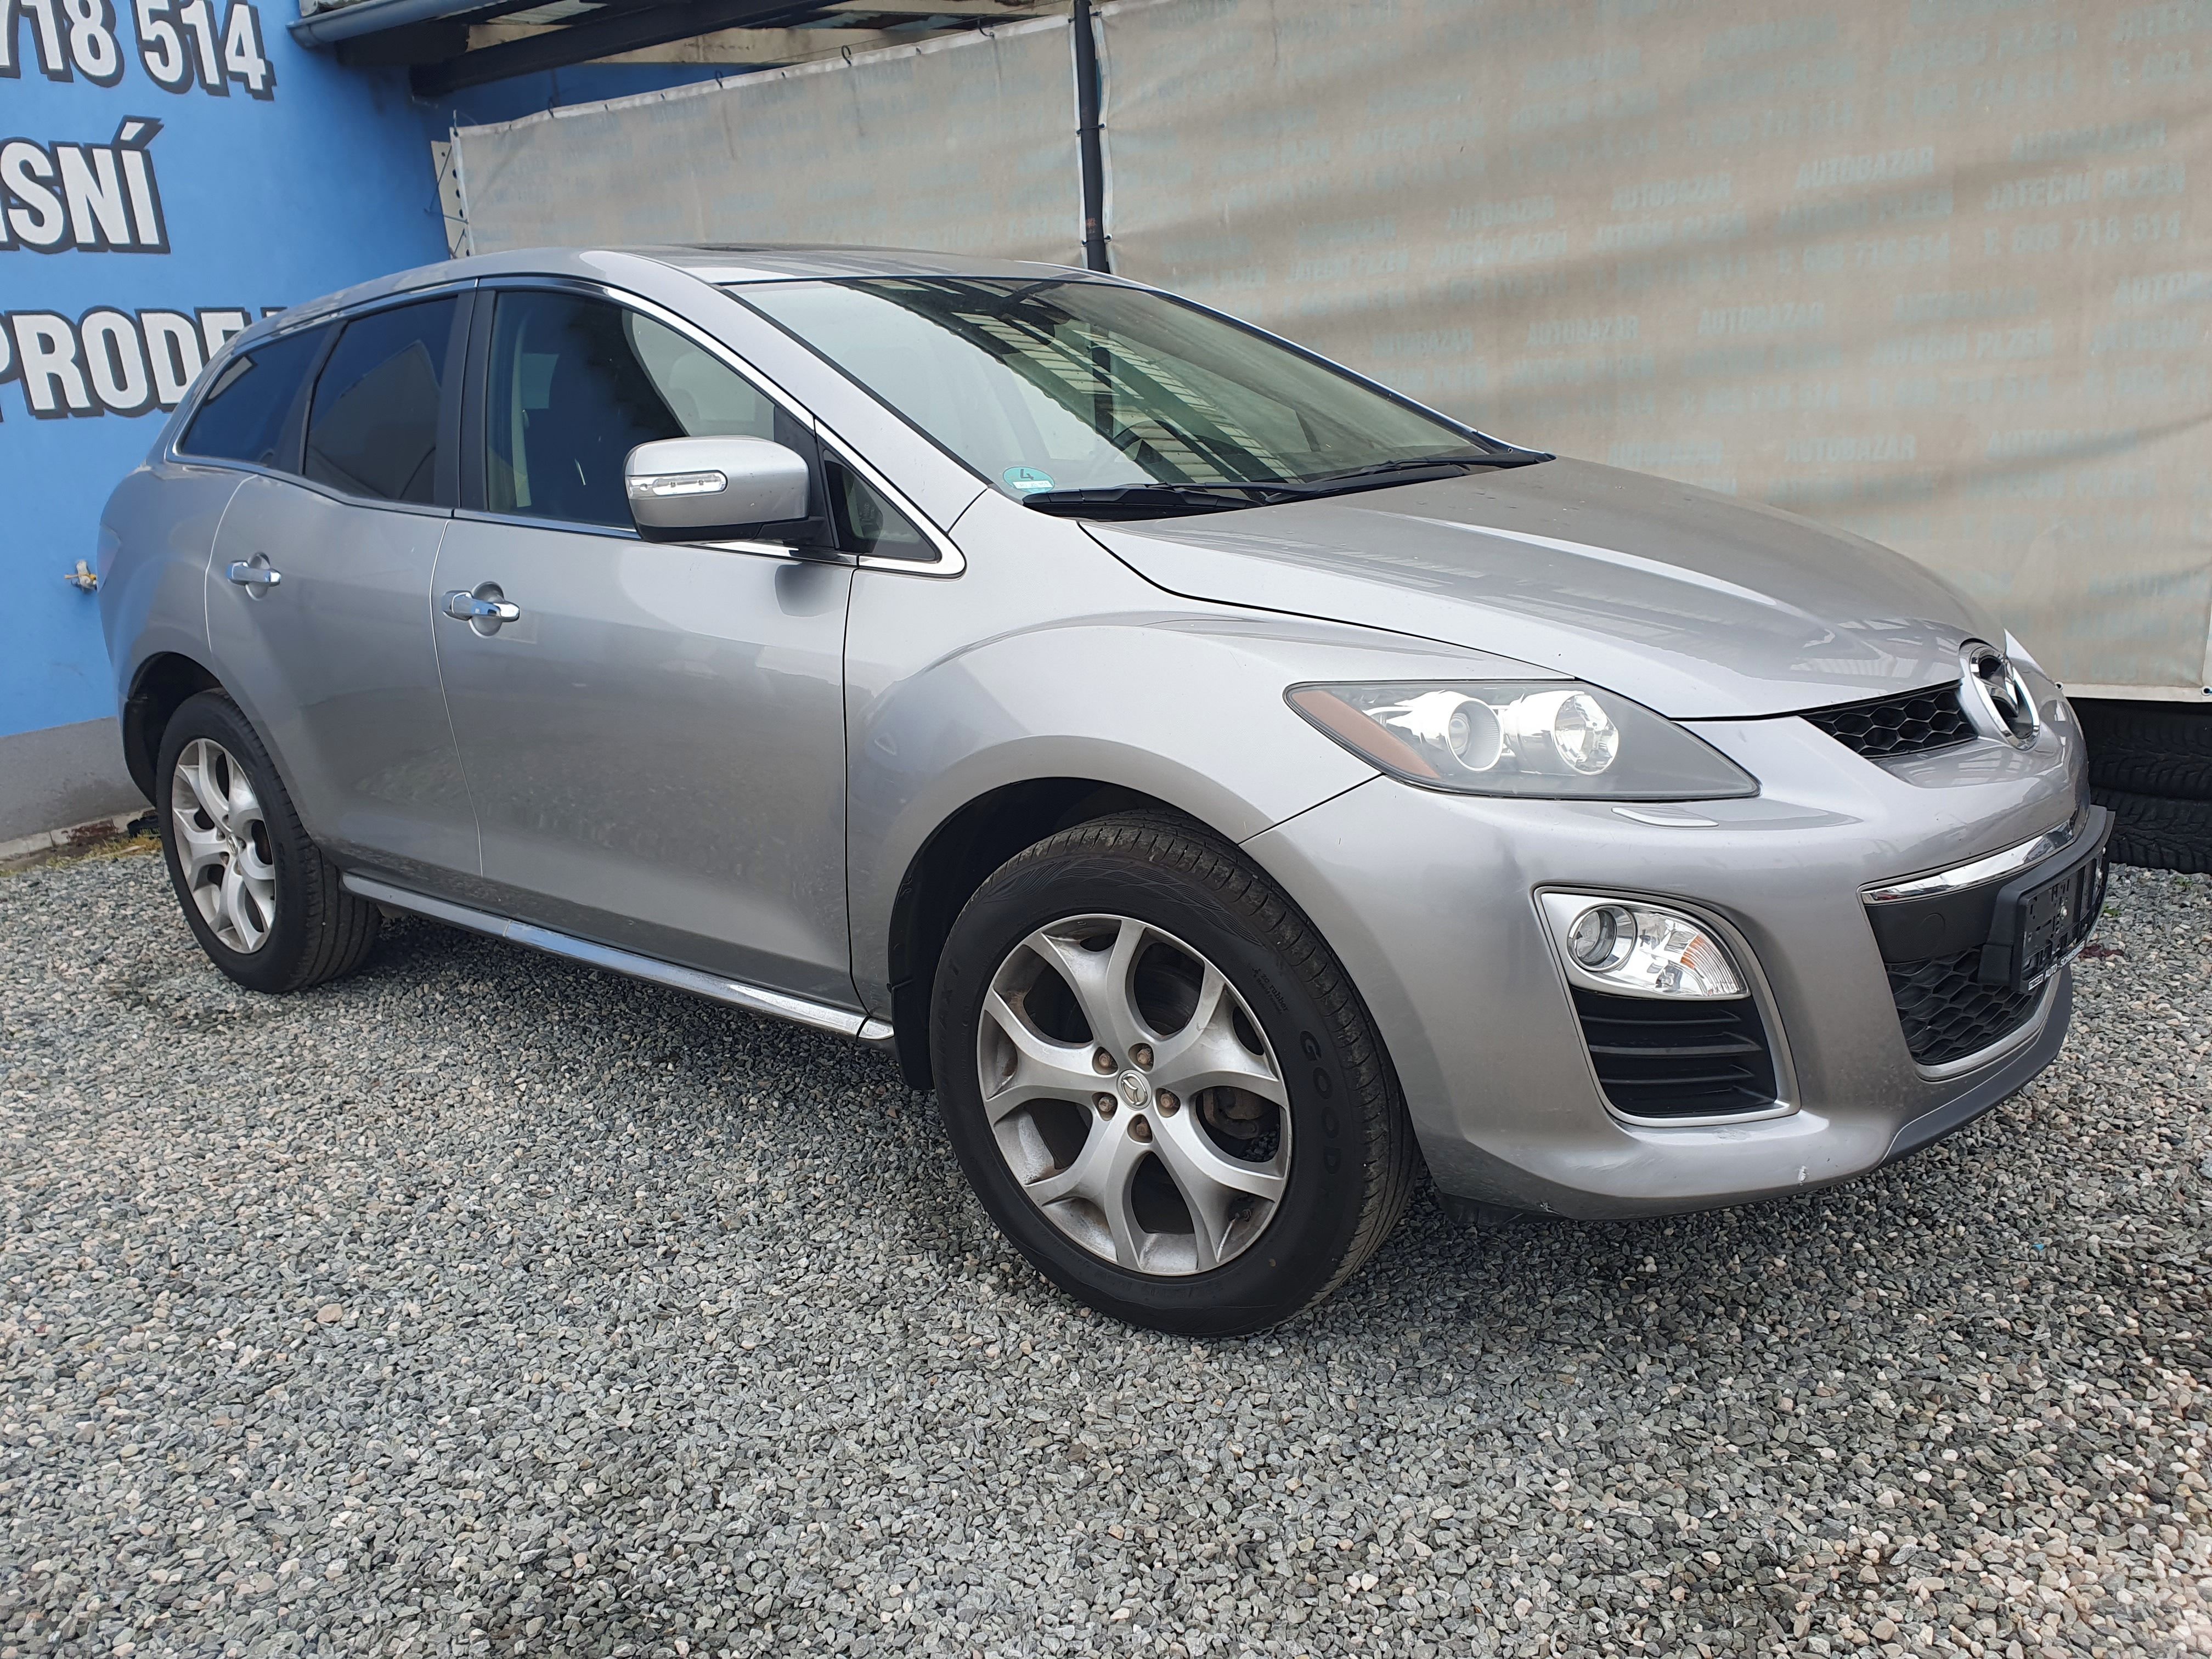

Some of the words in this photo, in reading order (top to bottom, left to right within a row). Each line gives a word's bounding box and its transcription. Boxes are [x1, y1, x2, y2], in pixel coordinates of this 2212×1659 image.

[0, 0, 121, 82] 18
[136, 0, 272, 97] 514
[0, 117, 166, 250] SNÍ
[0, 308, 286, 414] ROD
